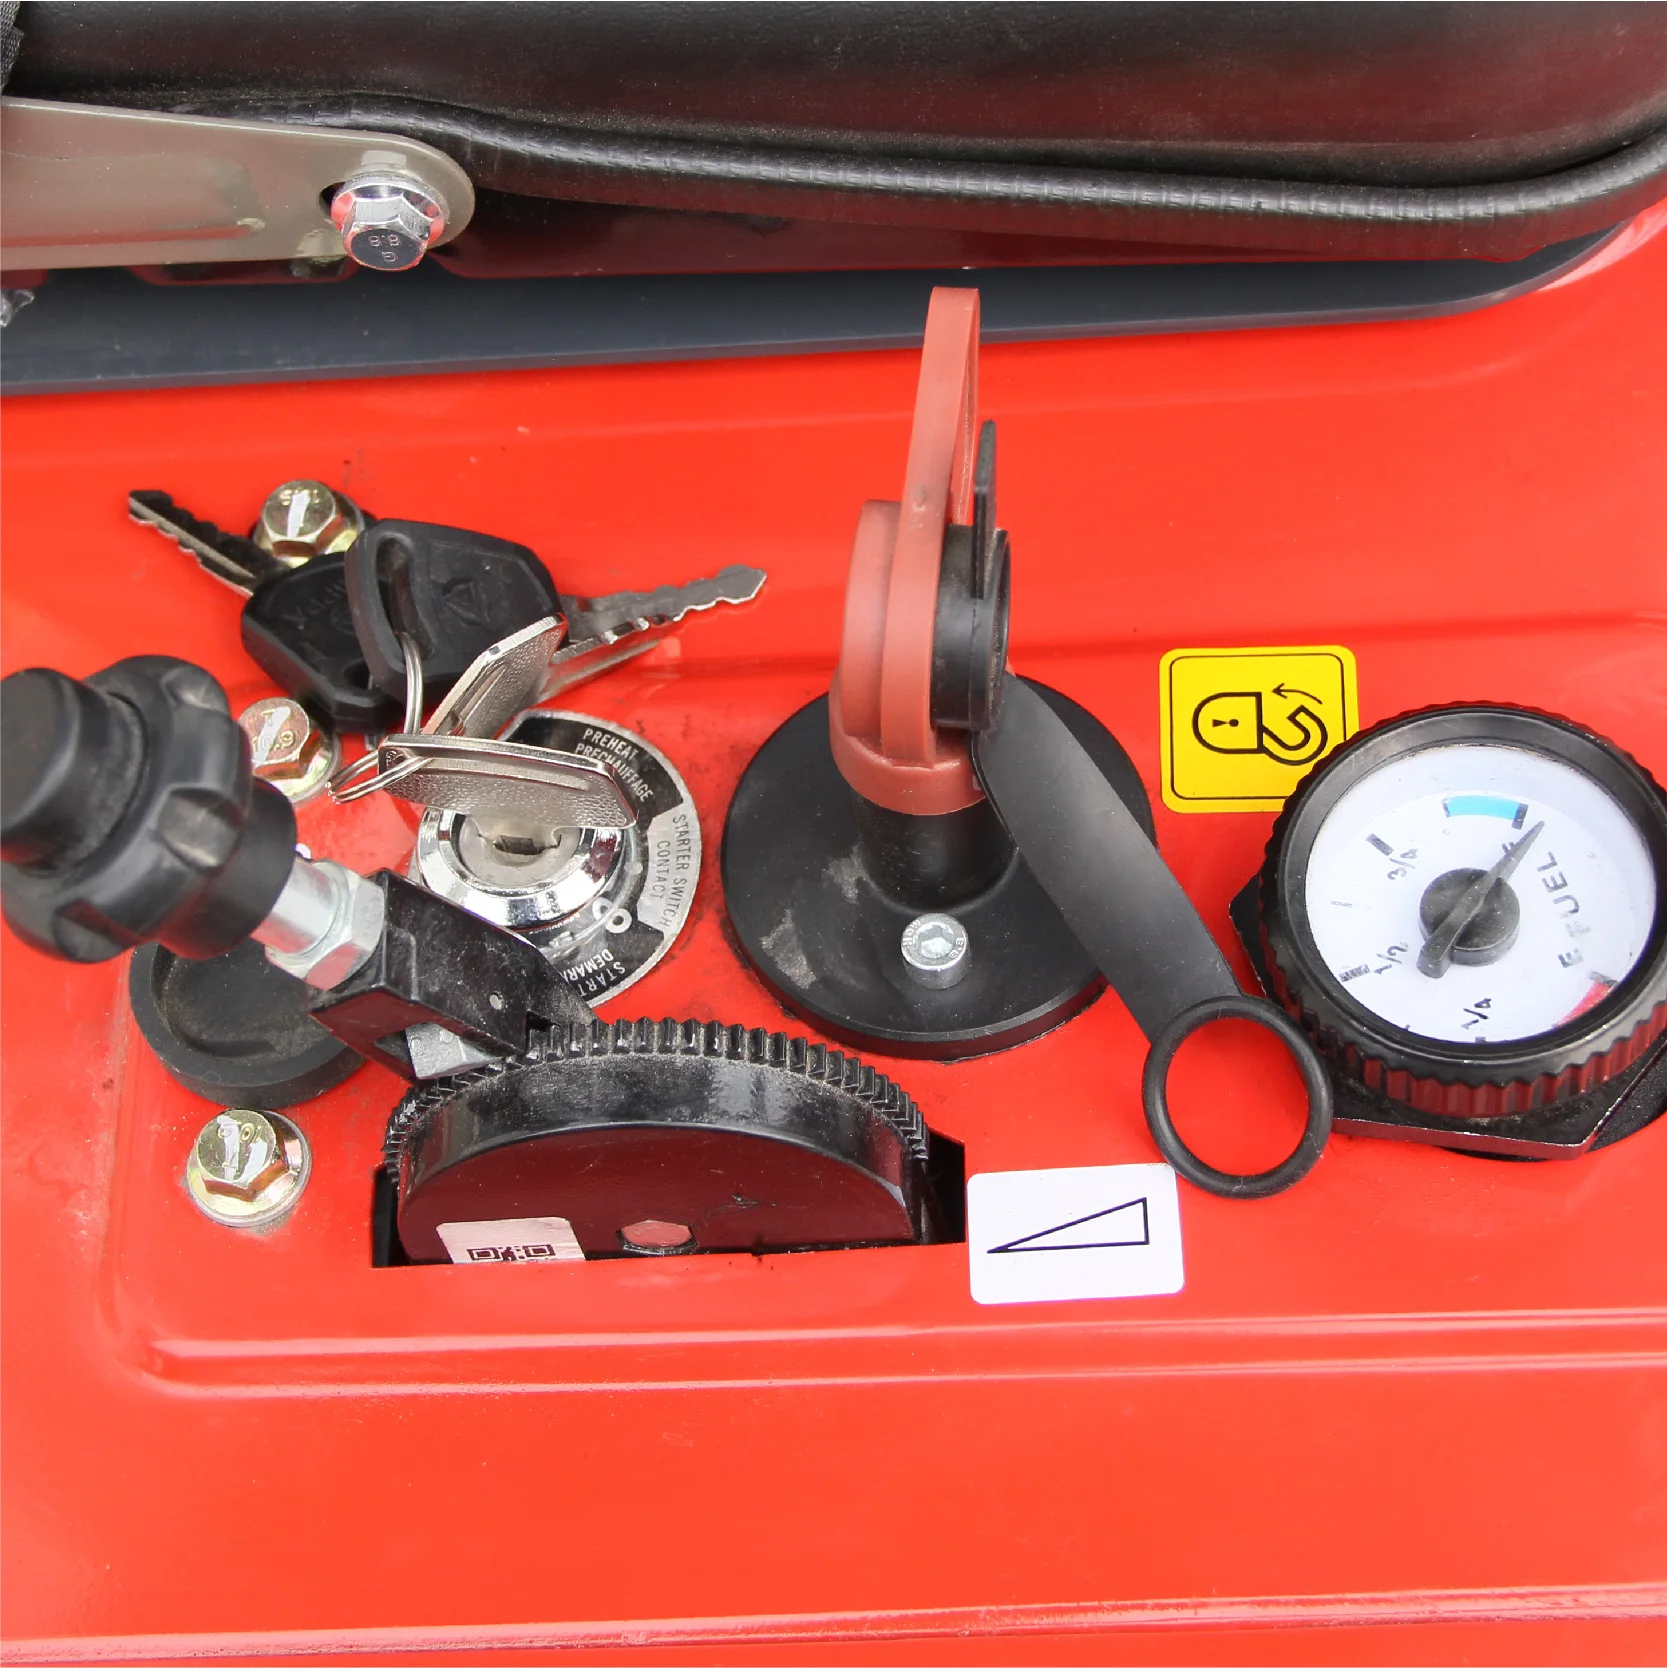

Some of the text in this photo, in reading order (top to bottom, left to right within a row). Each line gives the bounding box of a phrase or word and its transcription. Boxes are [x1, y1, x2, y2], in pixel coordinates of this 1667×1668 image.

[368, 234, 400, 247] 8.8
[582, 728, 639, 760] PREHEAT
[651, 840, 670, 900] CONTACT
[660, 814, 691, 927] STARTER SWITCH
[1537, 851, 1591, 938] FUEL
[1374, 942, 1409, 975] 1/2
[1557, 948, 1583, 968] E
[580, 961, 626, 997] START
